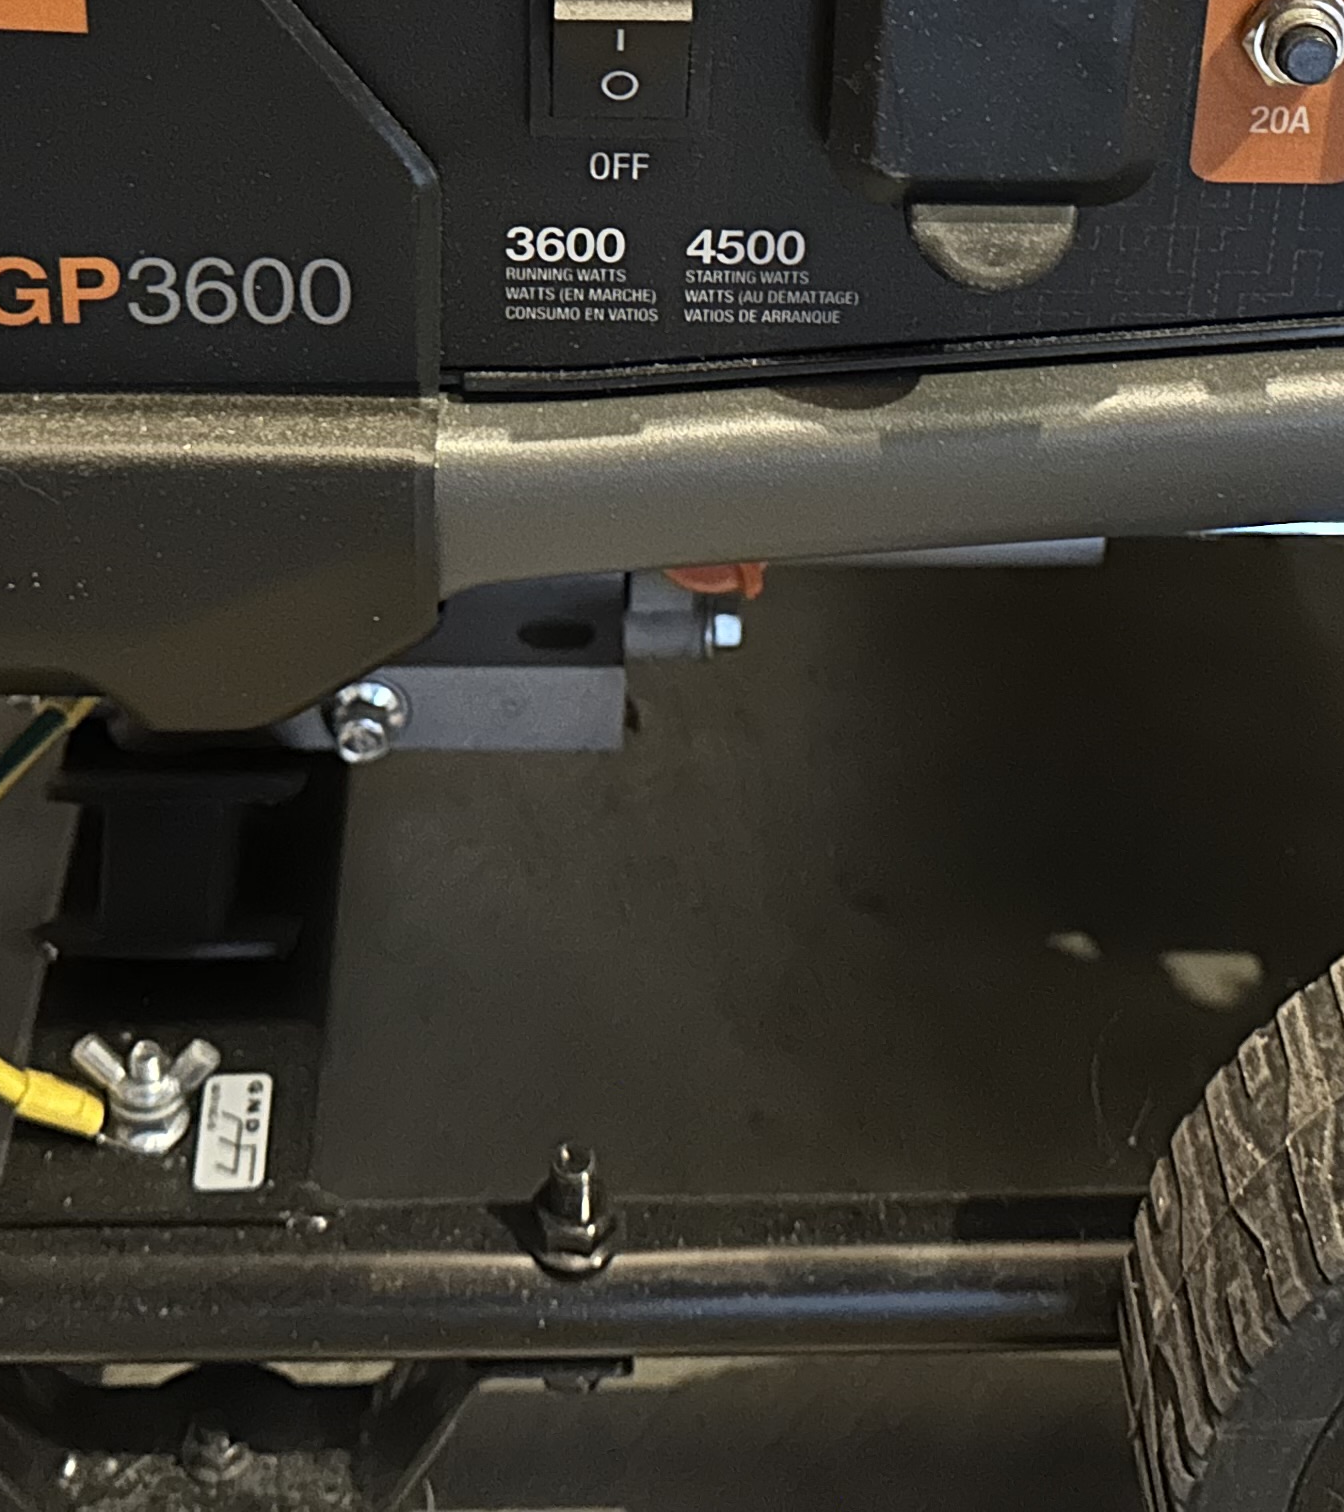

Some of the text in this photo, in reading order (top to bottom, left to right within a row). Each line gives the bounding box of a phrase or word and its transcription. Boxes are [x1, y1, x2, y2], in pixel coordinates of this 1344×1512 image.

[1249, 105, 1310, 134] 20A
[589, 152, 650, 180] OFF
[505, 226, 626, 263] 3600
[686, 229, 805, 266] 4500
[506, 267, 627, 282] RUNNING WATTS
[685, 269, 810, 285] STARTING WATTS
[505, 286, 657, 304] WATTS (EN MARCHE)
[684, 289, 734, 304] WATTS
[738, 290, 764, 306] (AU
[505, 306, 659, 322] CONSUMO EN VATIOS
[684, 308, 839, 324] VATIOS DE ARRANQUE
